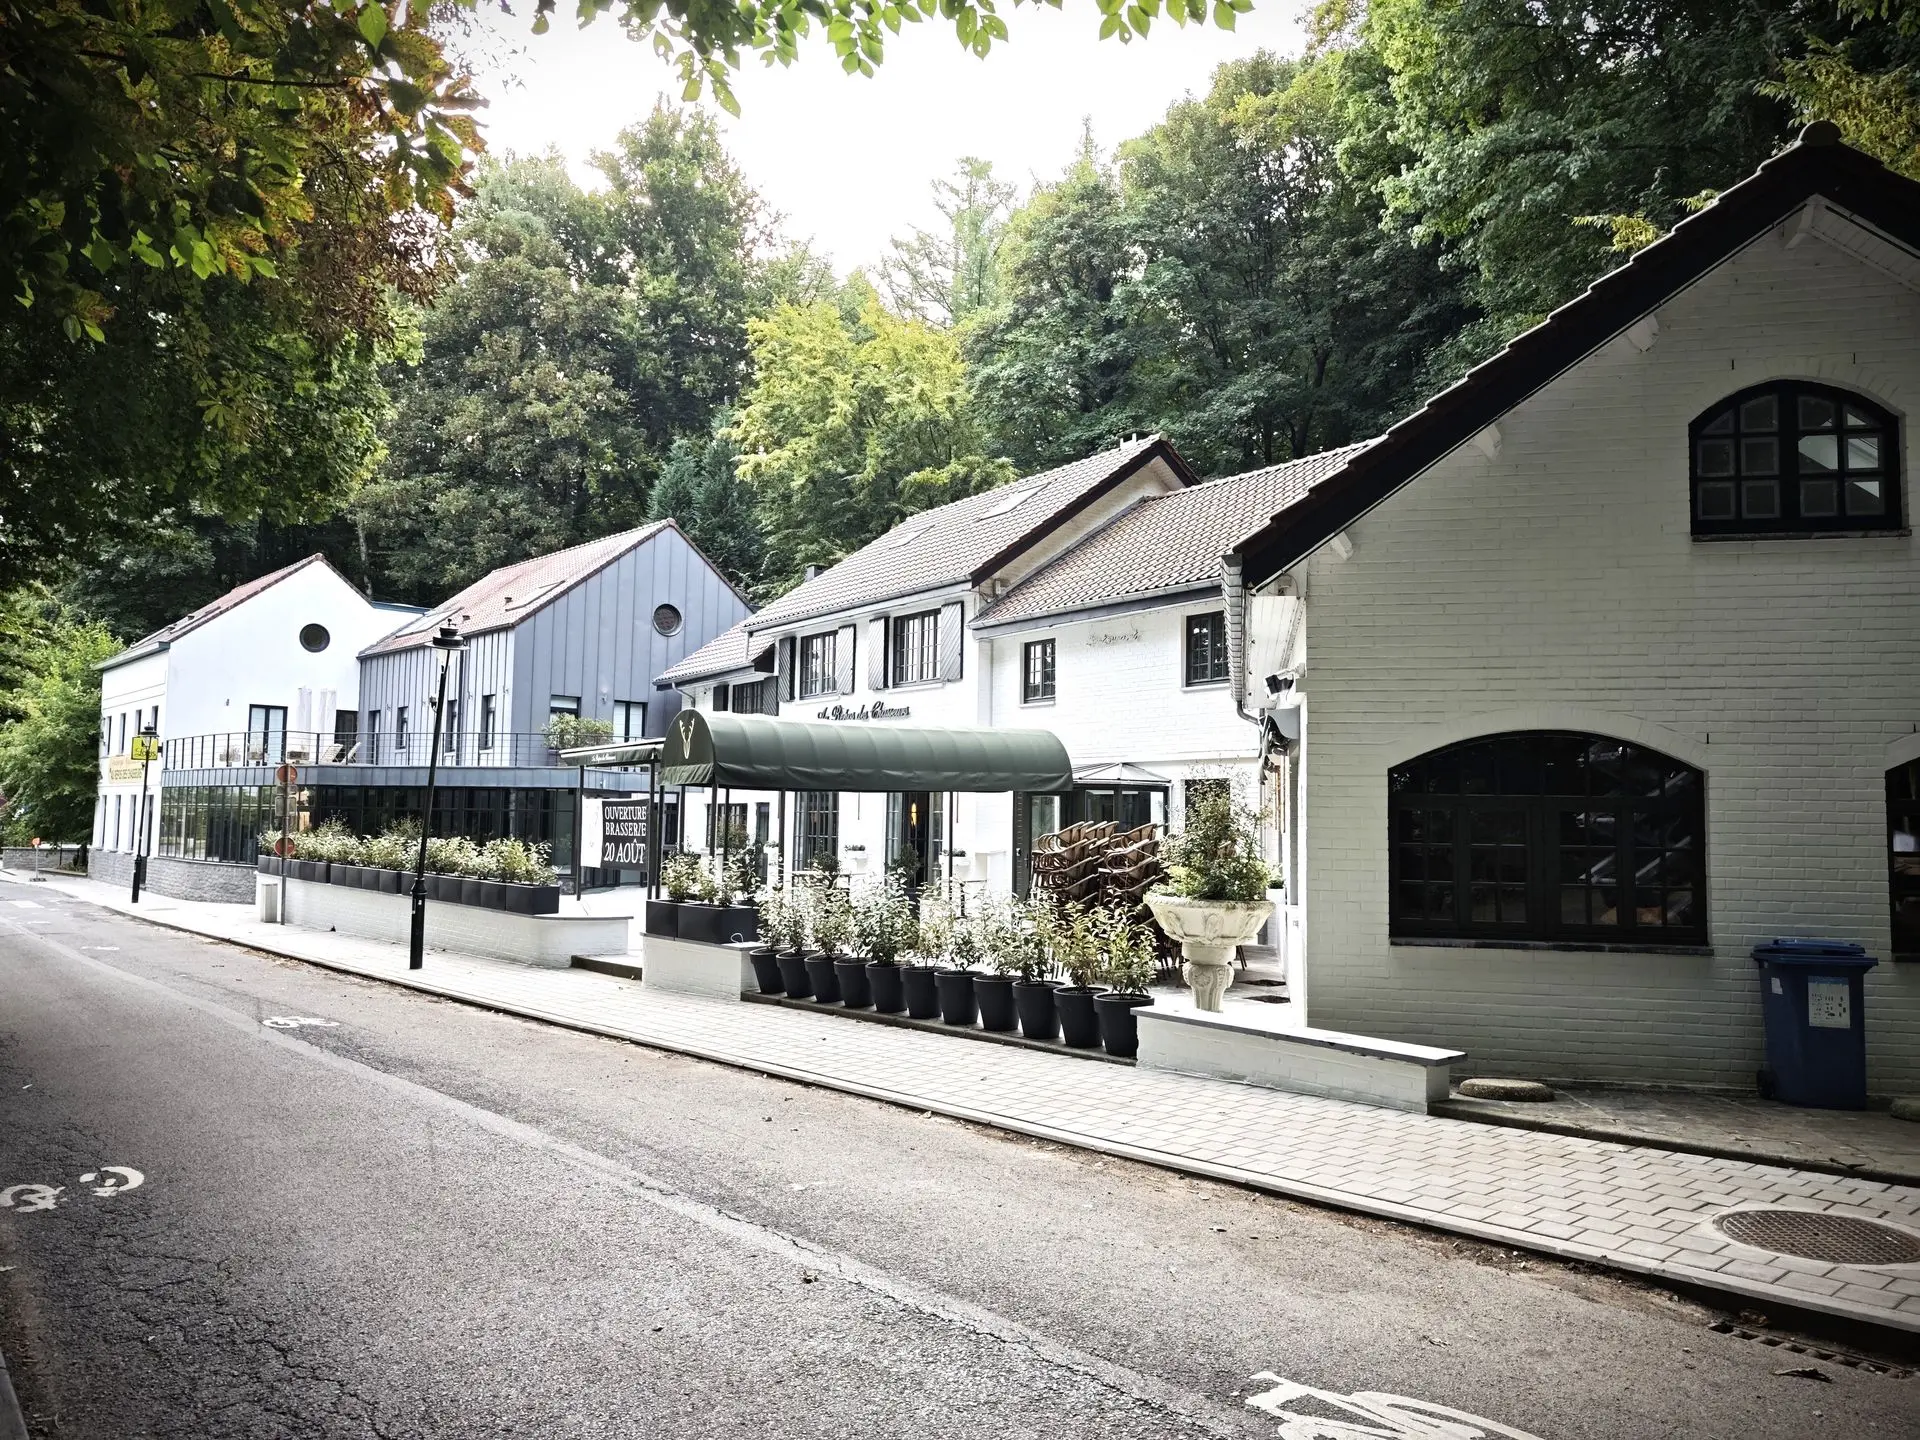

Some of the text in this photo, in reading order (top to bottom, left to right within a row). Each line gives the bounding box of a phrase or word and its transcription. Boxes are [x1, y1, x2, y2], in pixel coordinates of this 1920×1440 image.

[604, 805, 647, 821] OUVERTURE
[605, 821, 647, 837] BRASSERIE
[603, 838, 646, 864] 20 AOÛT
